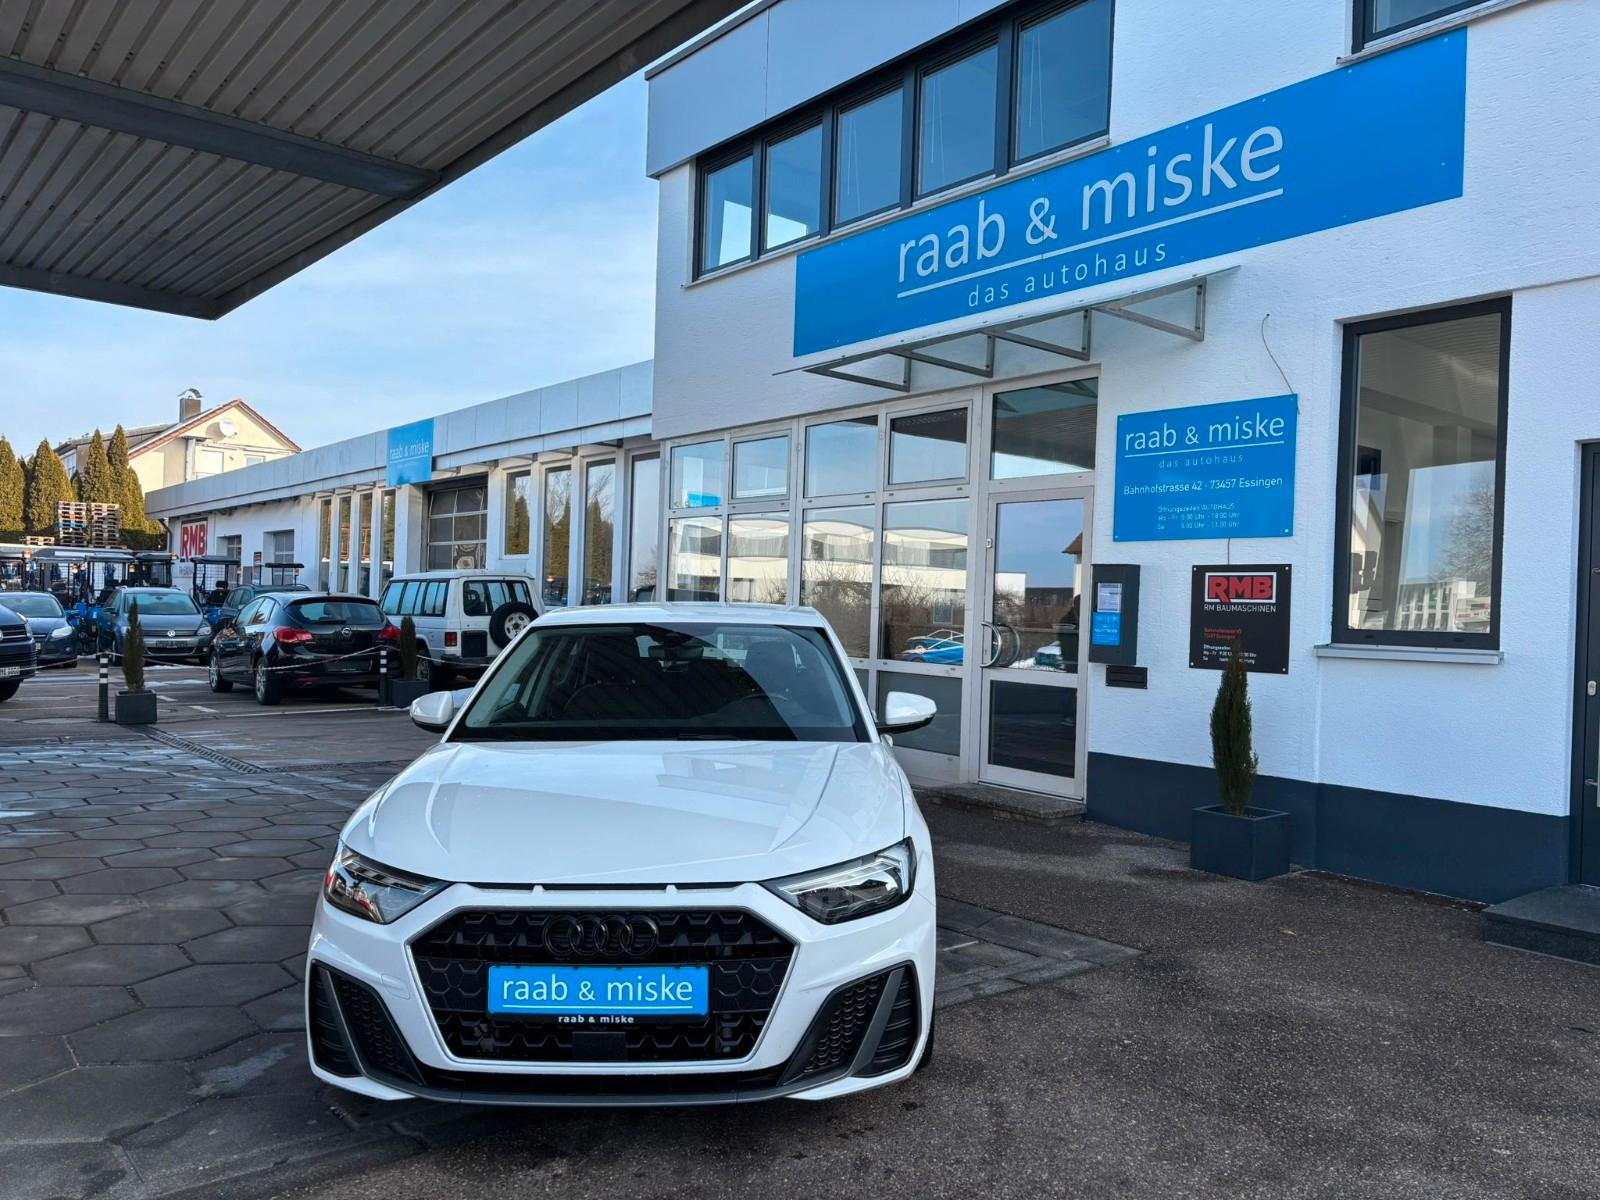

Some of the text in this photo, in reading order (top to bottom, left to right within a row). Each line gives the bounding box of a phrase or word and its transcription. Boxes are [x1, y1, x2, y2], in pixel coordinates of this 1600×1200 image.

[899, 122, 1283, 283] raab & miske
[968, 239, 1167, 307] das autohaus
[1125, 412, 1285, 451] raab & miske
[1159, 454, 1244, 469] das autohaus
[1123, 481, 1190, 496] Bahnhofstrasse
[1192, 480, 1202, 491] 42
[1210, 478, 1236, 490] 73457
[1239, 476, 1283, 490] Essingen
[181, 523, 206, 561] RMB
[1208, 575, 1272, 603] RMB
[1216, 604, 1277, 613] BAUMASCHINEN
[503, 973, 692, 1001] raab & miske
[558, 1014, 585, 1024] raab
[600, 1014, 634, 1024] miske
